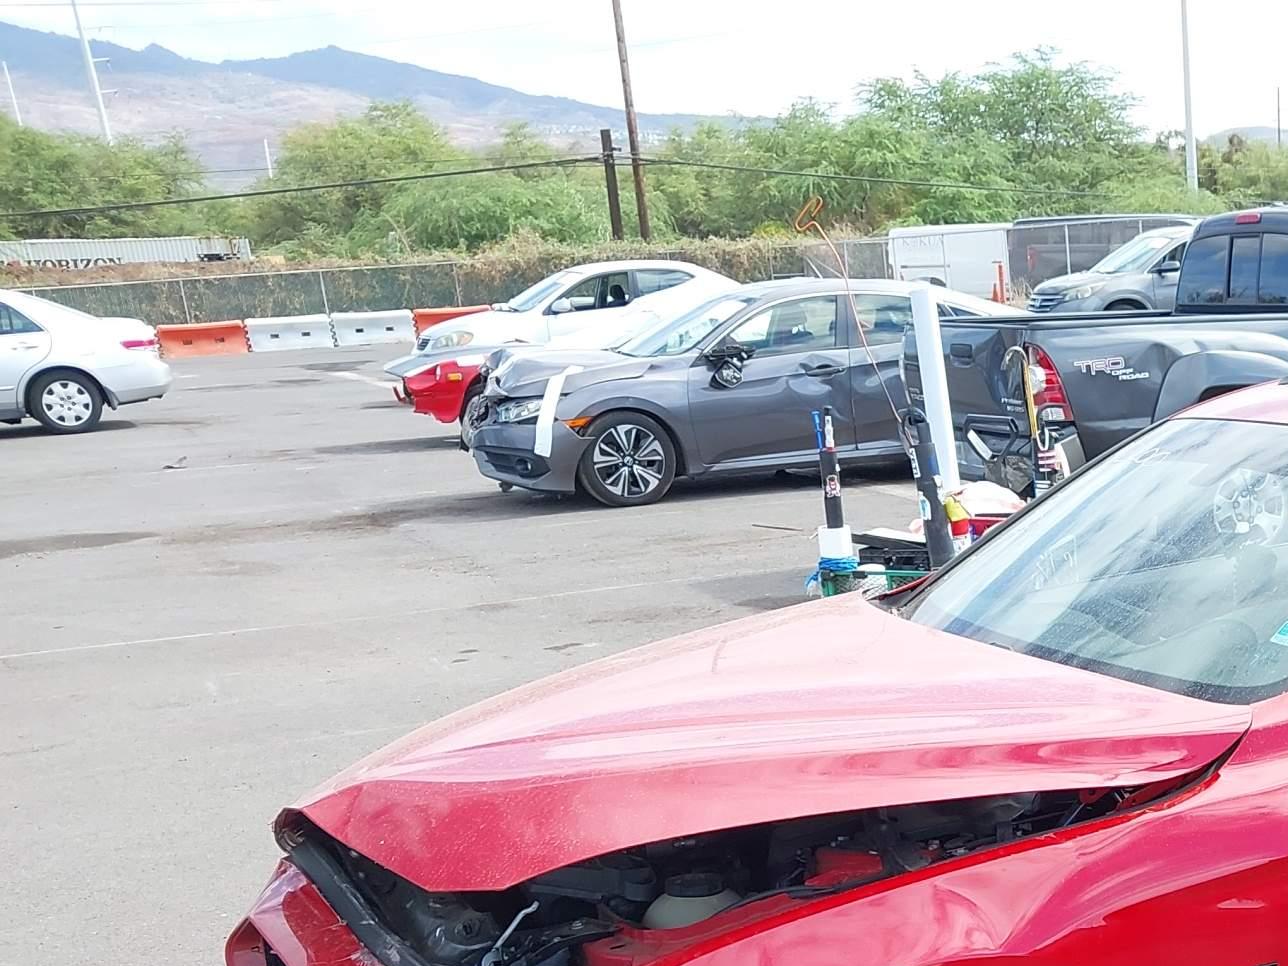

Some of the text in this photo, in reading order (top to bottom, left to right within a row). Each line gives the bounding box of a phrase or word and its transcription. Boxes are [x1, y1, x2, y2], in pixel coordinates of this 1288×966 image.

[1073, 356, 1125, 376] TRD
[1112, 368, 1134, 376] OFF
[1118, 372, 1150, 381] ROAD
